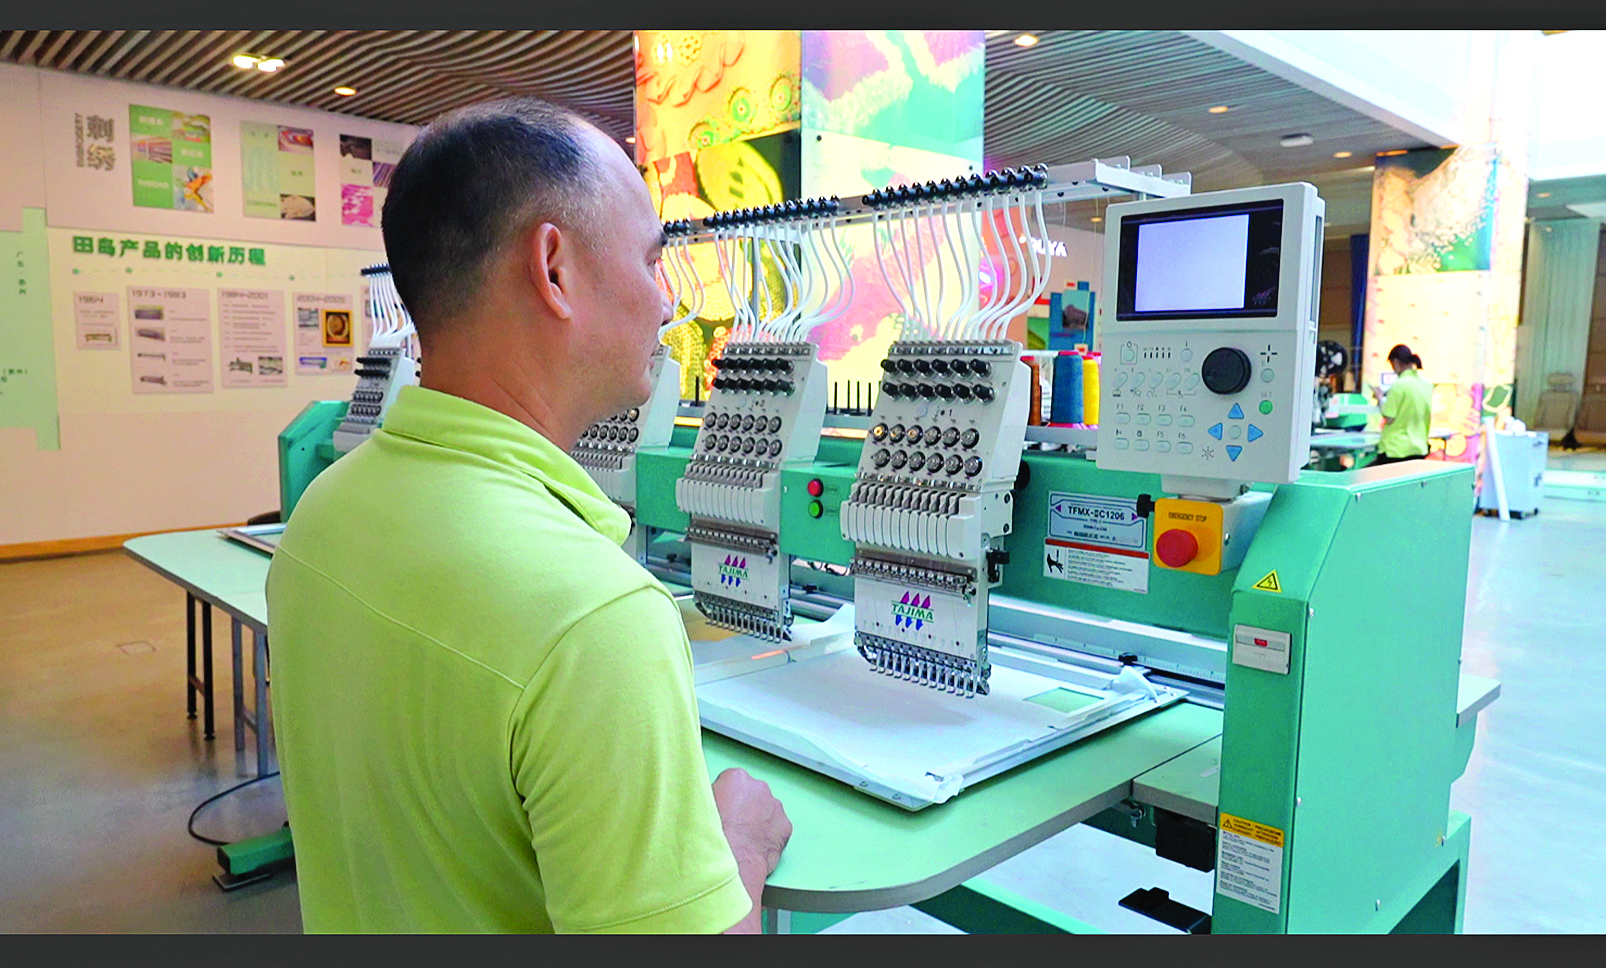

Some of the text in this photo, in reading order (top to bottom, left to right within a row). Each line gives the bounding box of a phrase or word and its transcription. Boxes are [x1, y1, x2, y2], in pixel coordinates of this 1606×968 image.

[73, 236, 266, 266] 田岛产品的创新历程
[1168, 512, 1193, 521] EMERGENCY
[718, 563, 748, 579] TAJIMA
[892, 602, 934, 621] TAJIMA
